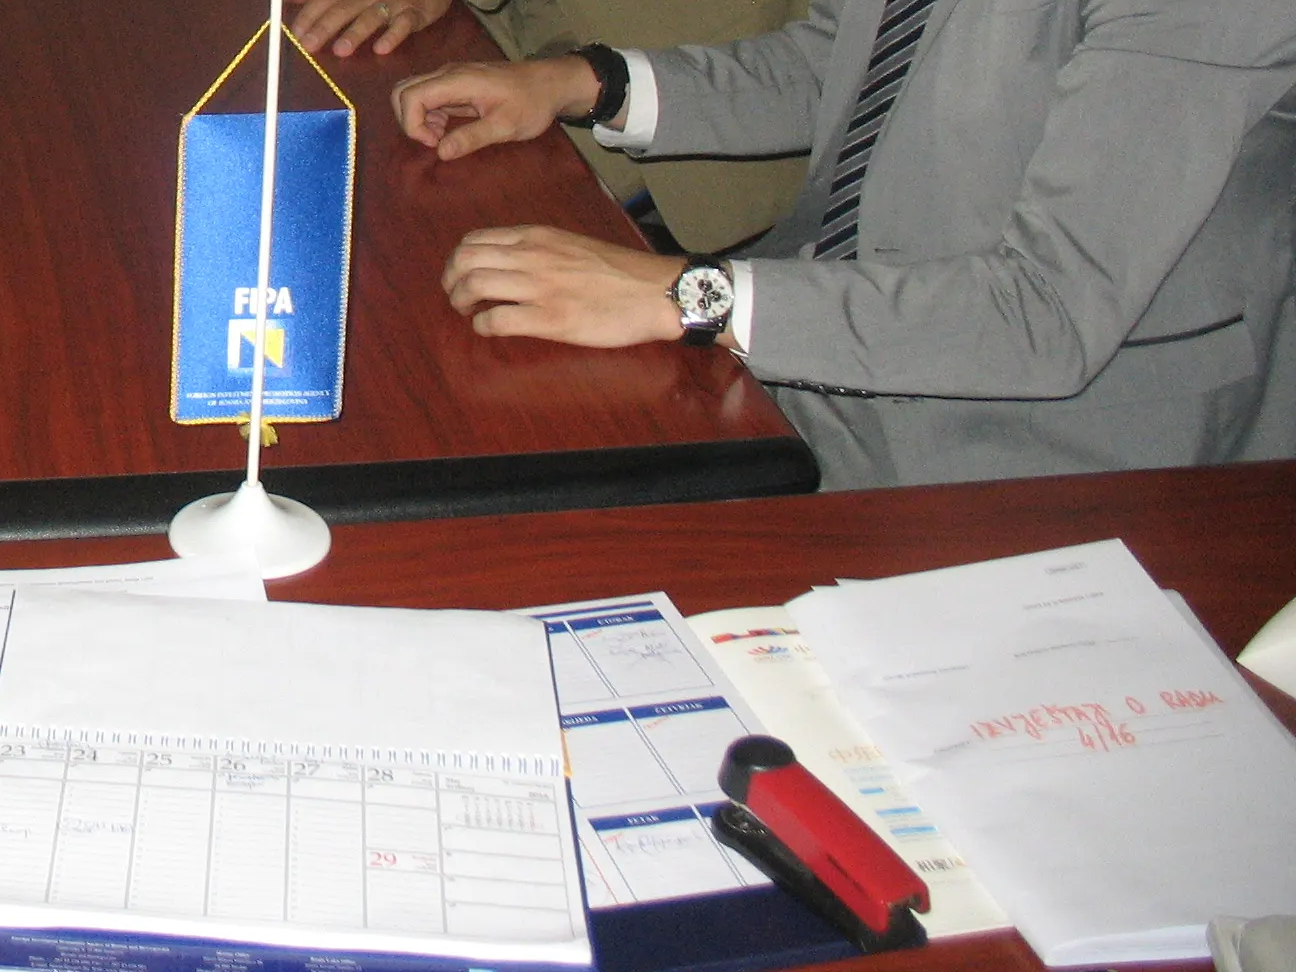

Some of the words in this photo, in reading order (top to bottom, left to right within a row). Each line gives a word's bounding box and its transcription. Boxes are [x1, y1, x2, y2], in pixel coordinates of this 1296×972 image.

[234, 287, 294, 315] FIPA
[0, 744, 26, 757] 23
[72, 748, 98, 761] 24
[146, 752, 173, 766] 25
[220, 757, 246, 772] 26
[293, 761, 320, 776] 27
[367, 768, 394, 782] 28
[370, 851, 397, 867] 29
